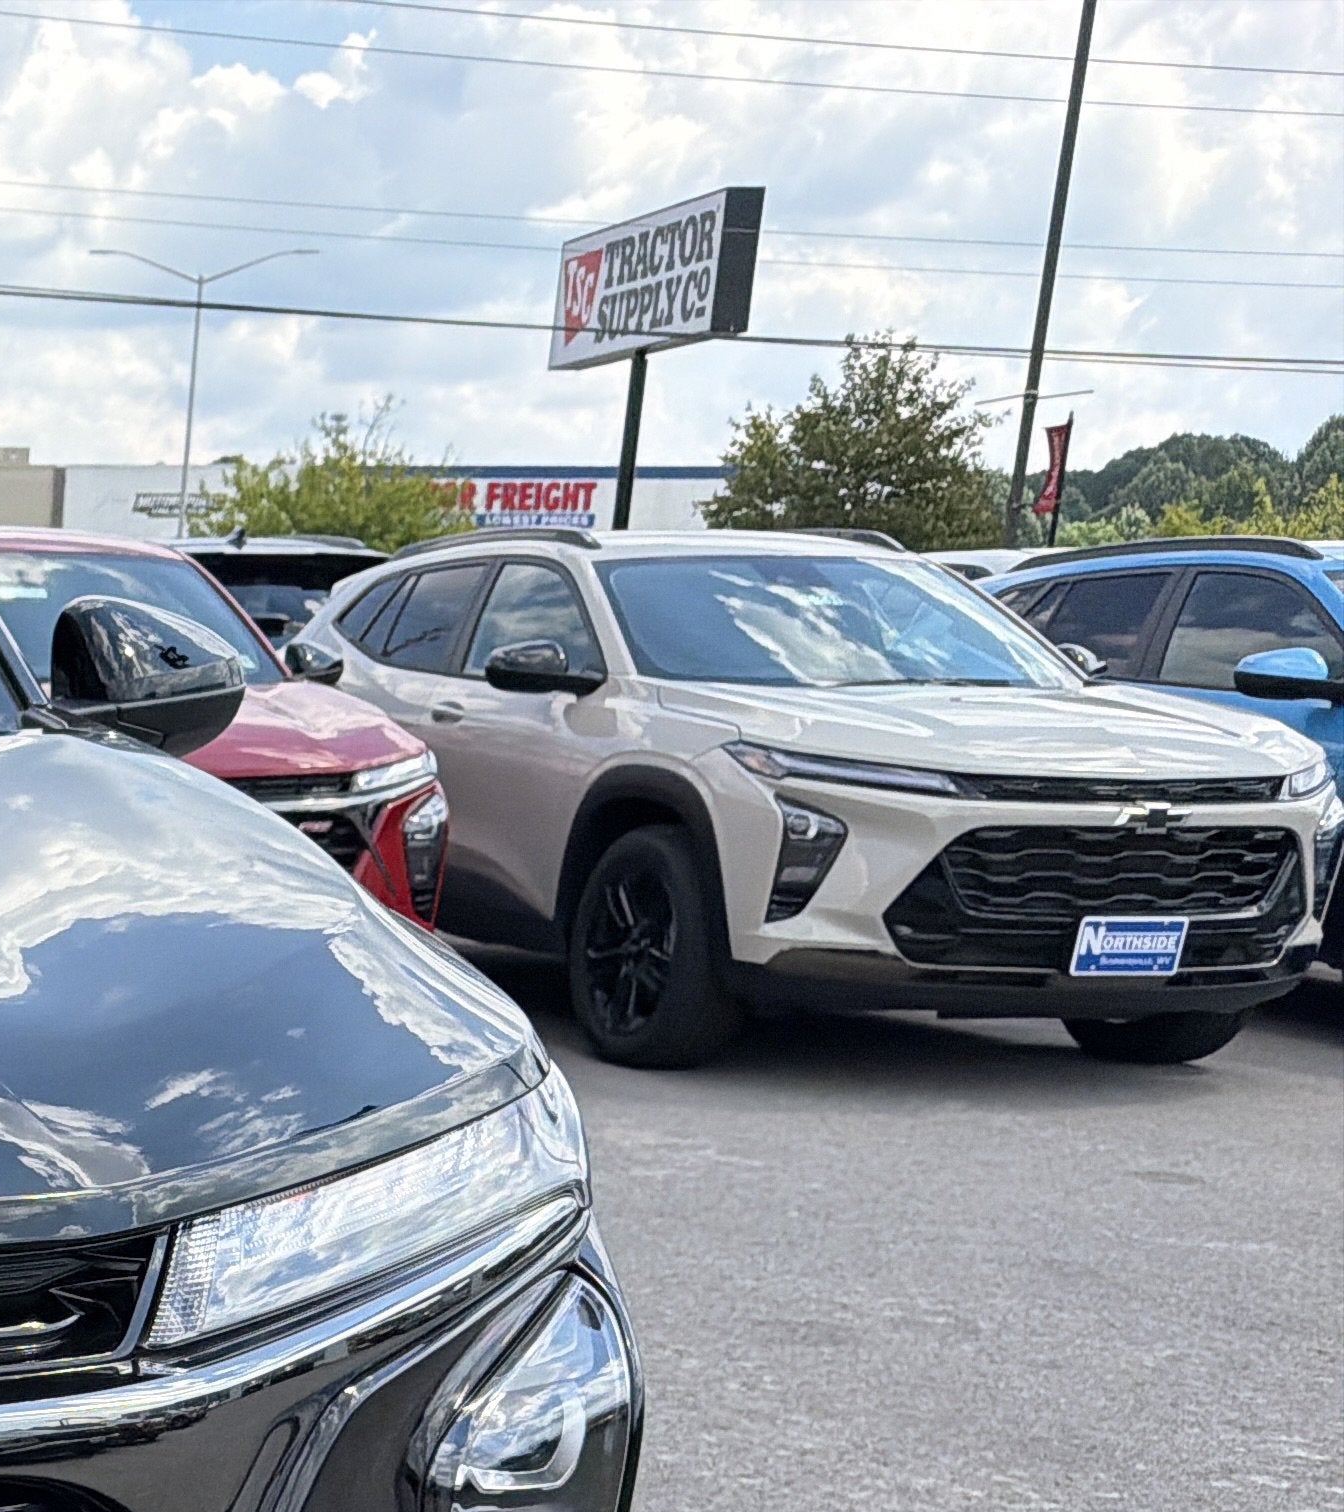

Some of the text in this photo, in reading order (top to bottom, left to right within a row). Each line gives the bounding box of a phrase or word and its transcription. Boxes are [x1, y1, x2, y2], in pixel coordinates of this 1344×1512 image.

[603, 209, 717, 290] TRACTOR
[565, 259, 595, 326] TSC
[593, 273, 683, 344] SUPPLY
[484, 482, 598, 512] FREIGHT
[1080, 925, 1178, 956] NORTHSIDE
